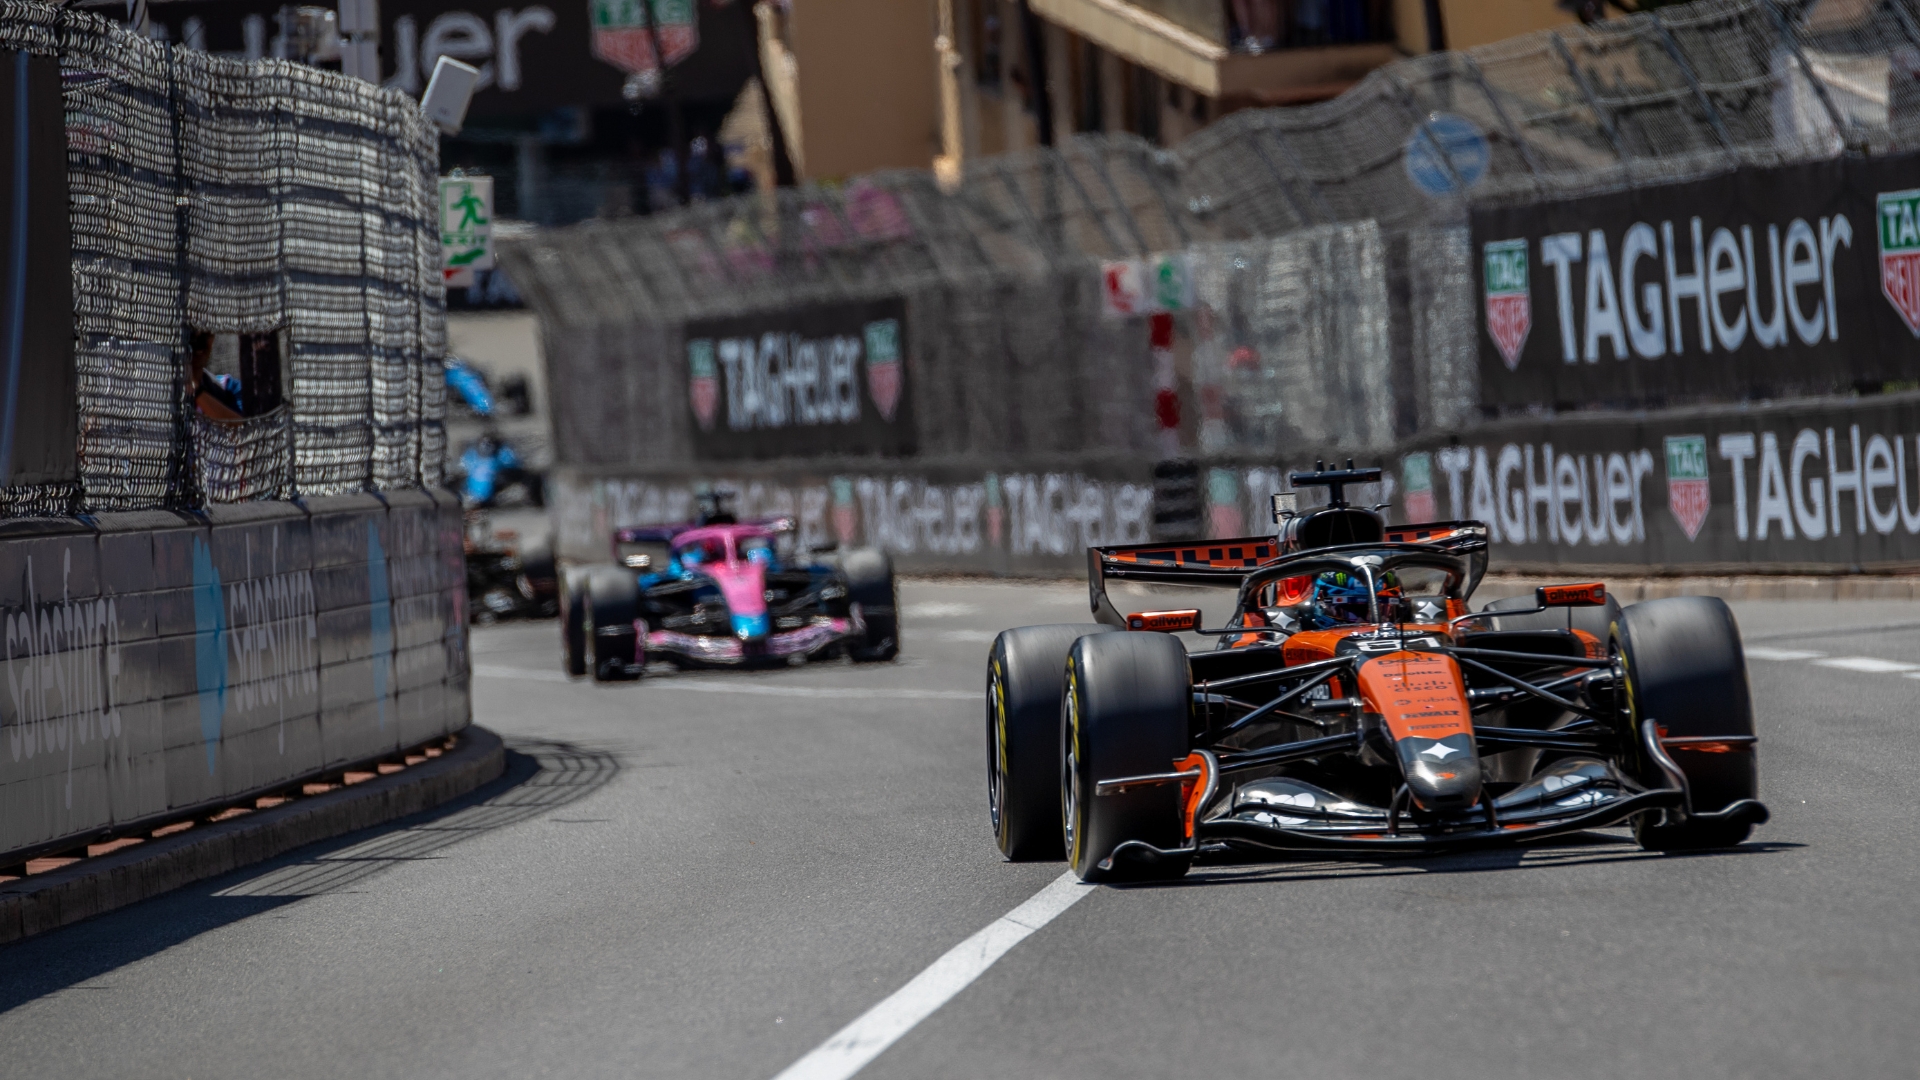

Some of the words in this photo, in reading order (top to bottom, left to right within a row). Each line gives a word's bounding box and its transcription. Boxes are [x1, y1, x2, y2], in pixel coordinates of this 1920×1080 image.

[1540, 213, 1853, 364] TAGHeuer
[1550, 588, 1588, 600] allwyn
[1149, 615, 1192, 628] allwyn
[1356, 637, 1441, 652] 81
[6, 547, 121, 809] salesforce
